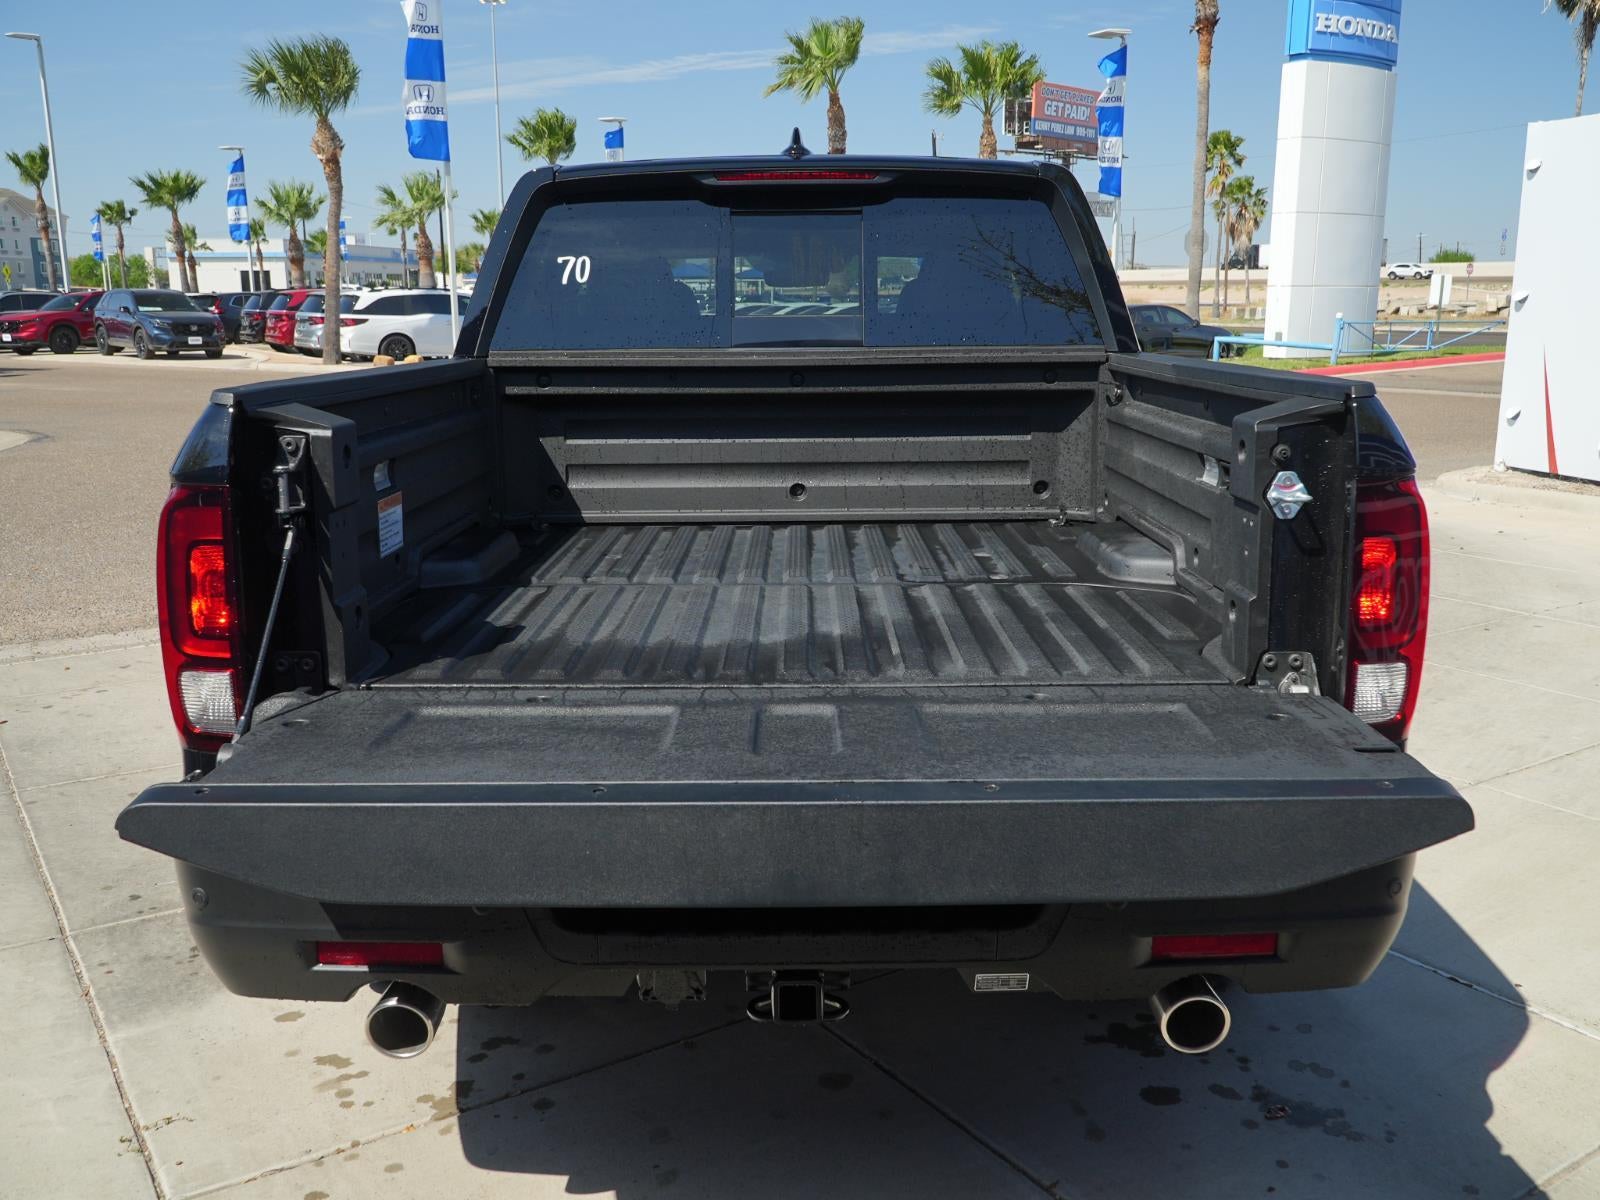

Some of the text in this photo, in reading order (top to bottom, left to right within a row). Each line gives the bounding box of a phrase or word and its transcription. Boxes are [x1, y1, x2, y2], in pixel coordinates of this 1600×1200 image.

[1315, 13, 1398, 43] HONDA
[1060, 90, 1071, 100] GET
[1045, 100, 1090, 121] GET PAID!
[557, 255, 591, 285] 70
